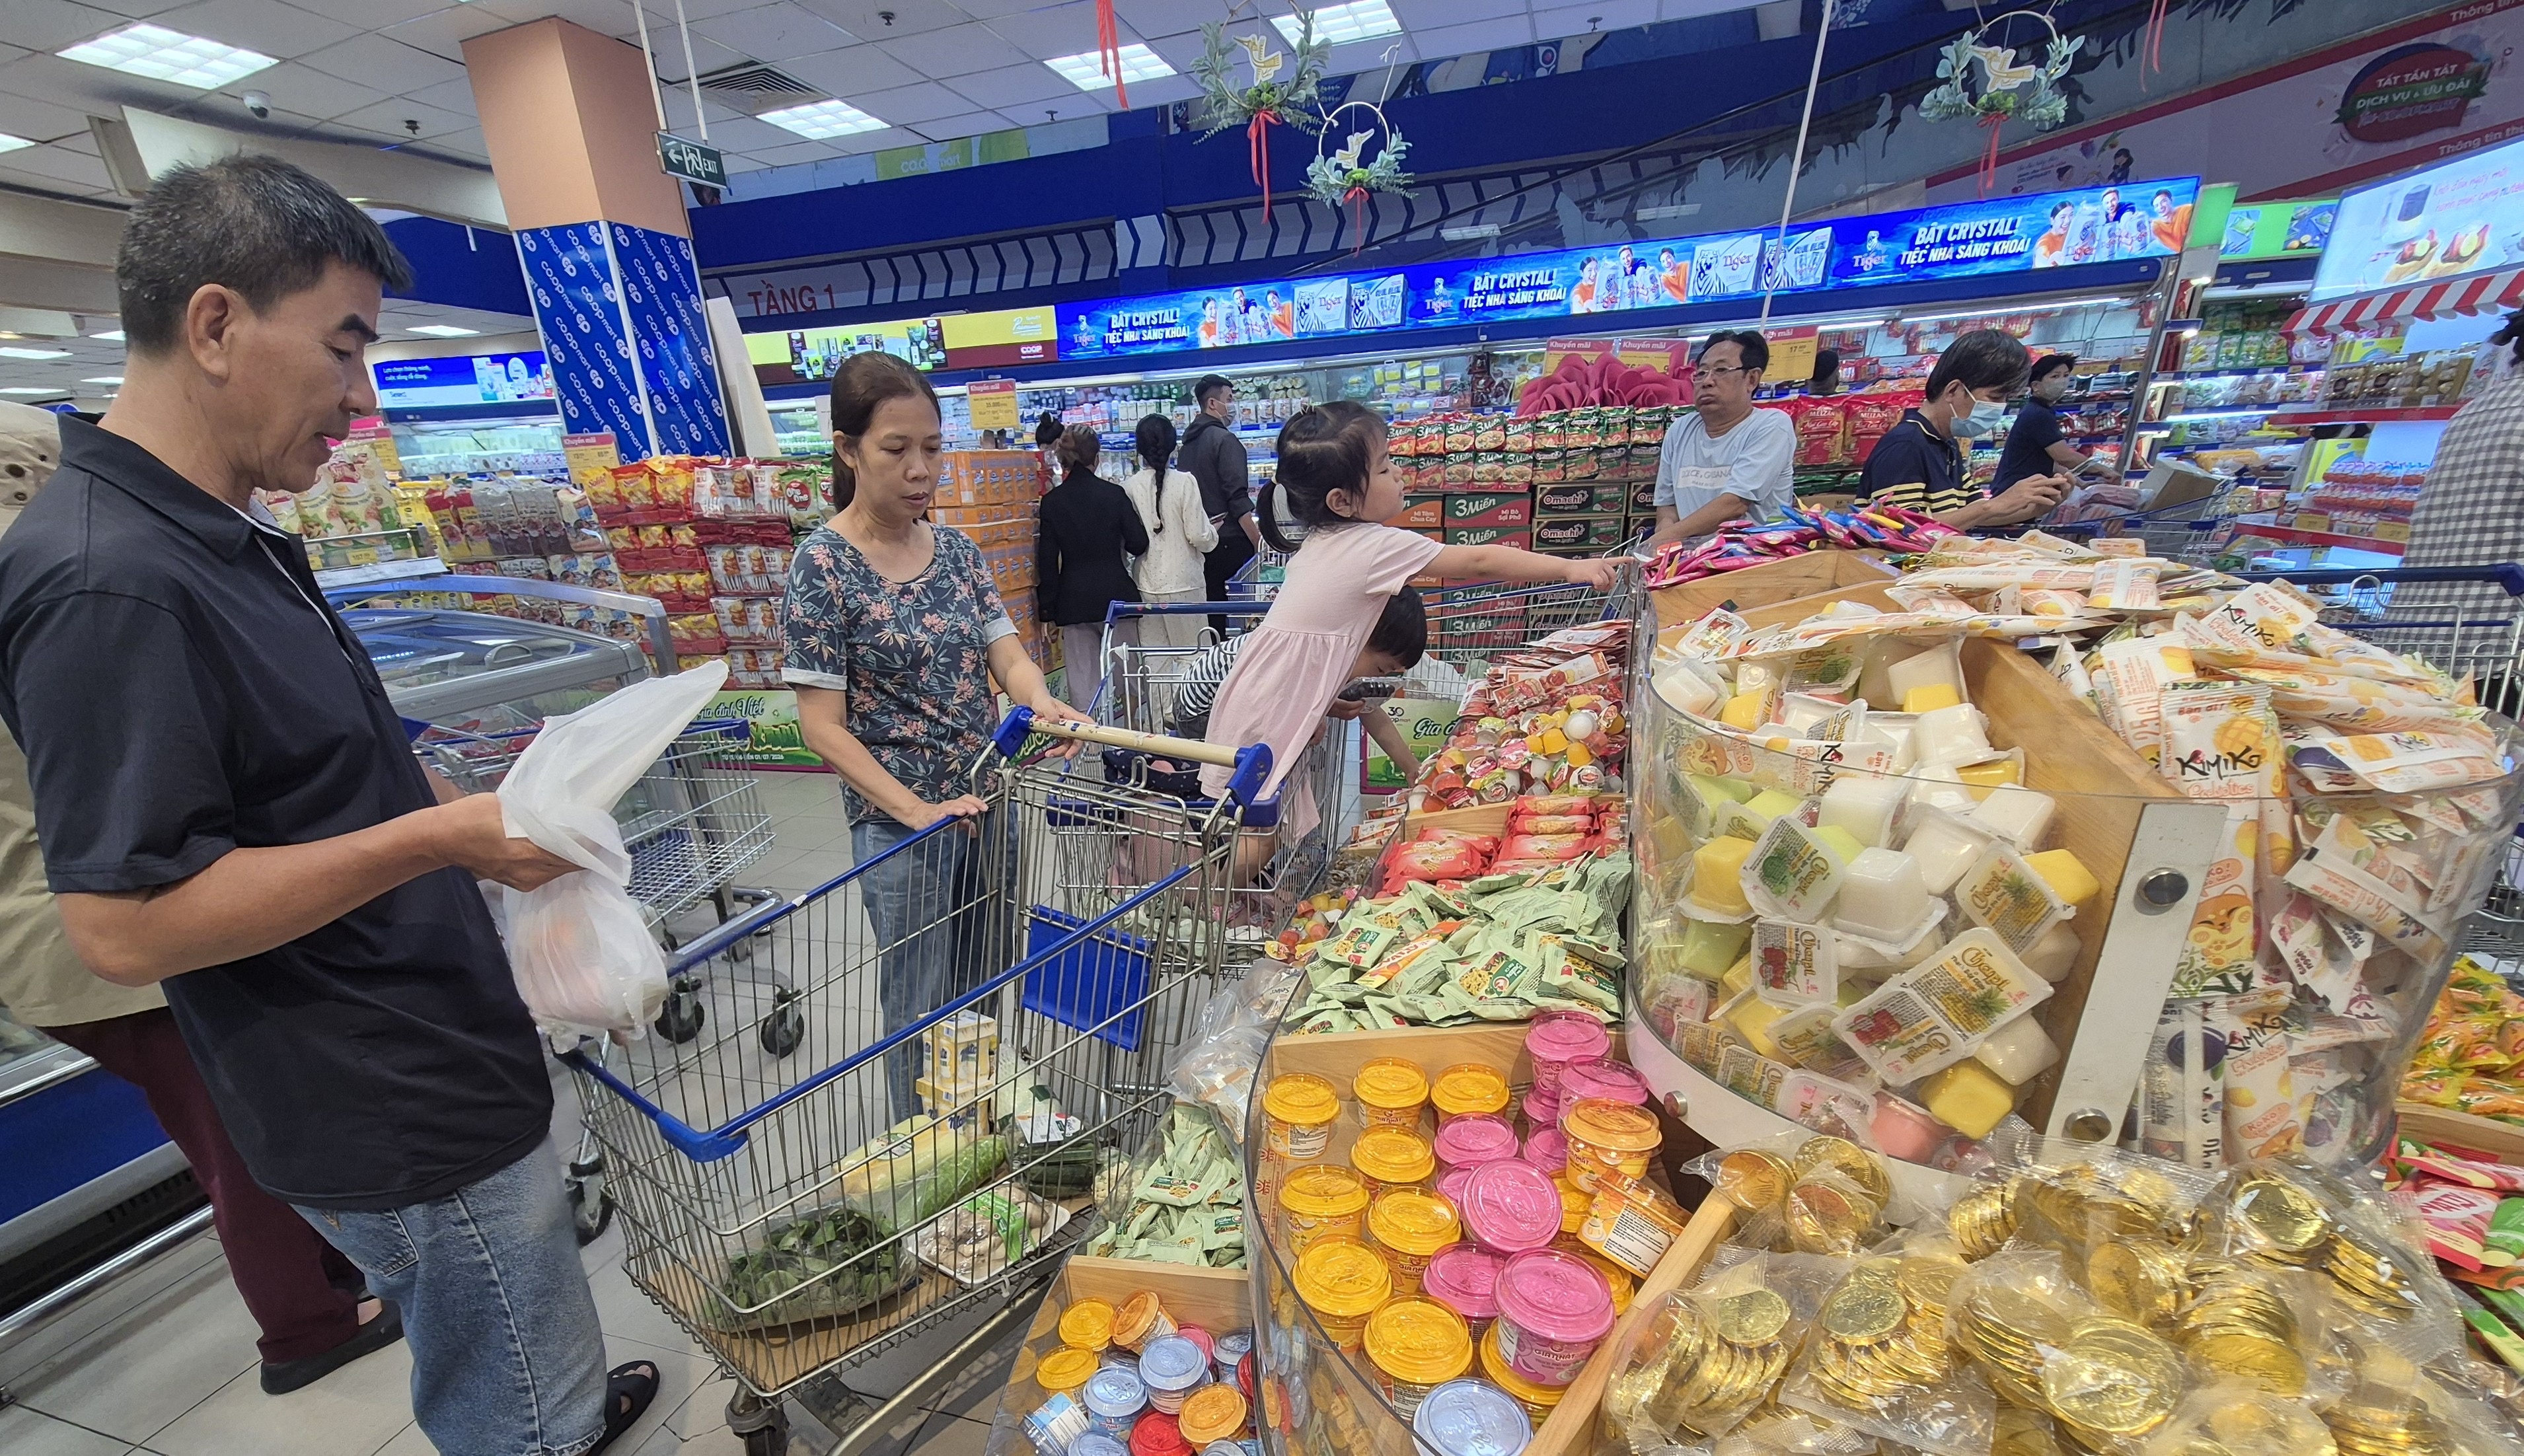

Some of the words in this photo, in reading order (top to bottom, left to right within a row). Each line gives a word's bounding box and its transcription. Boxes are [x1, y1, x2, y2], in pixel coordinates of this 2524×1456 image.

[2450, 1, 2494, 22] Thông
[2439, 137, 2482, 157] Thông
[702, 158, 718, 174] EXIT
[1915, 222, 1947, 249] BẬT
[1947, 216, 2023, 242] CRYSTAL!
[1900, 246, 1925, 268] TIỆC
[1473, 272, 1498, 295] BẬT
[1499, 269, 1557, 289] CRYSTAL!
[747, 279, 818, 316] TẦNG
[824, 283, 835, 310] 1
[1464, 293, 1485, 312] TIỆC
[1111, 310, 1132, 332] BẬT
[1132, 308, 1180, 327] CRYSTAL!
[1105, 330, 1123, 347] TIỆC
[1549, 340, 1576, 349] Khuyến
[1623, 340, 1651, 349] Khuyến
[1543, 494, 1582, 506] Omachi
[1540, 527, 1579, 539] Omachi
[1413, 717, 1442, 740] Gia
[1804, 743, 1844, 797] KIMIK
[2175, 745, 2262, 781] KIMIKO
